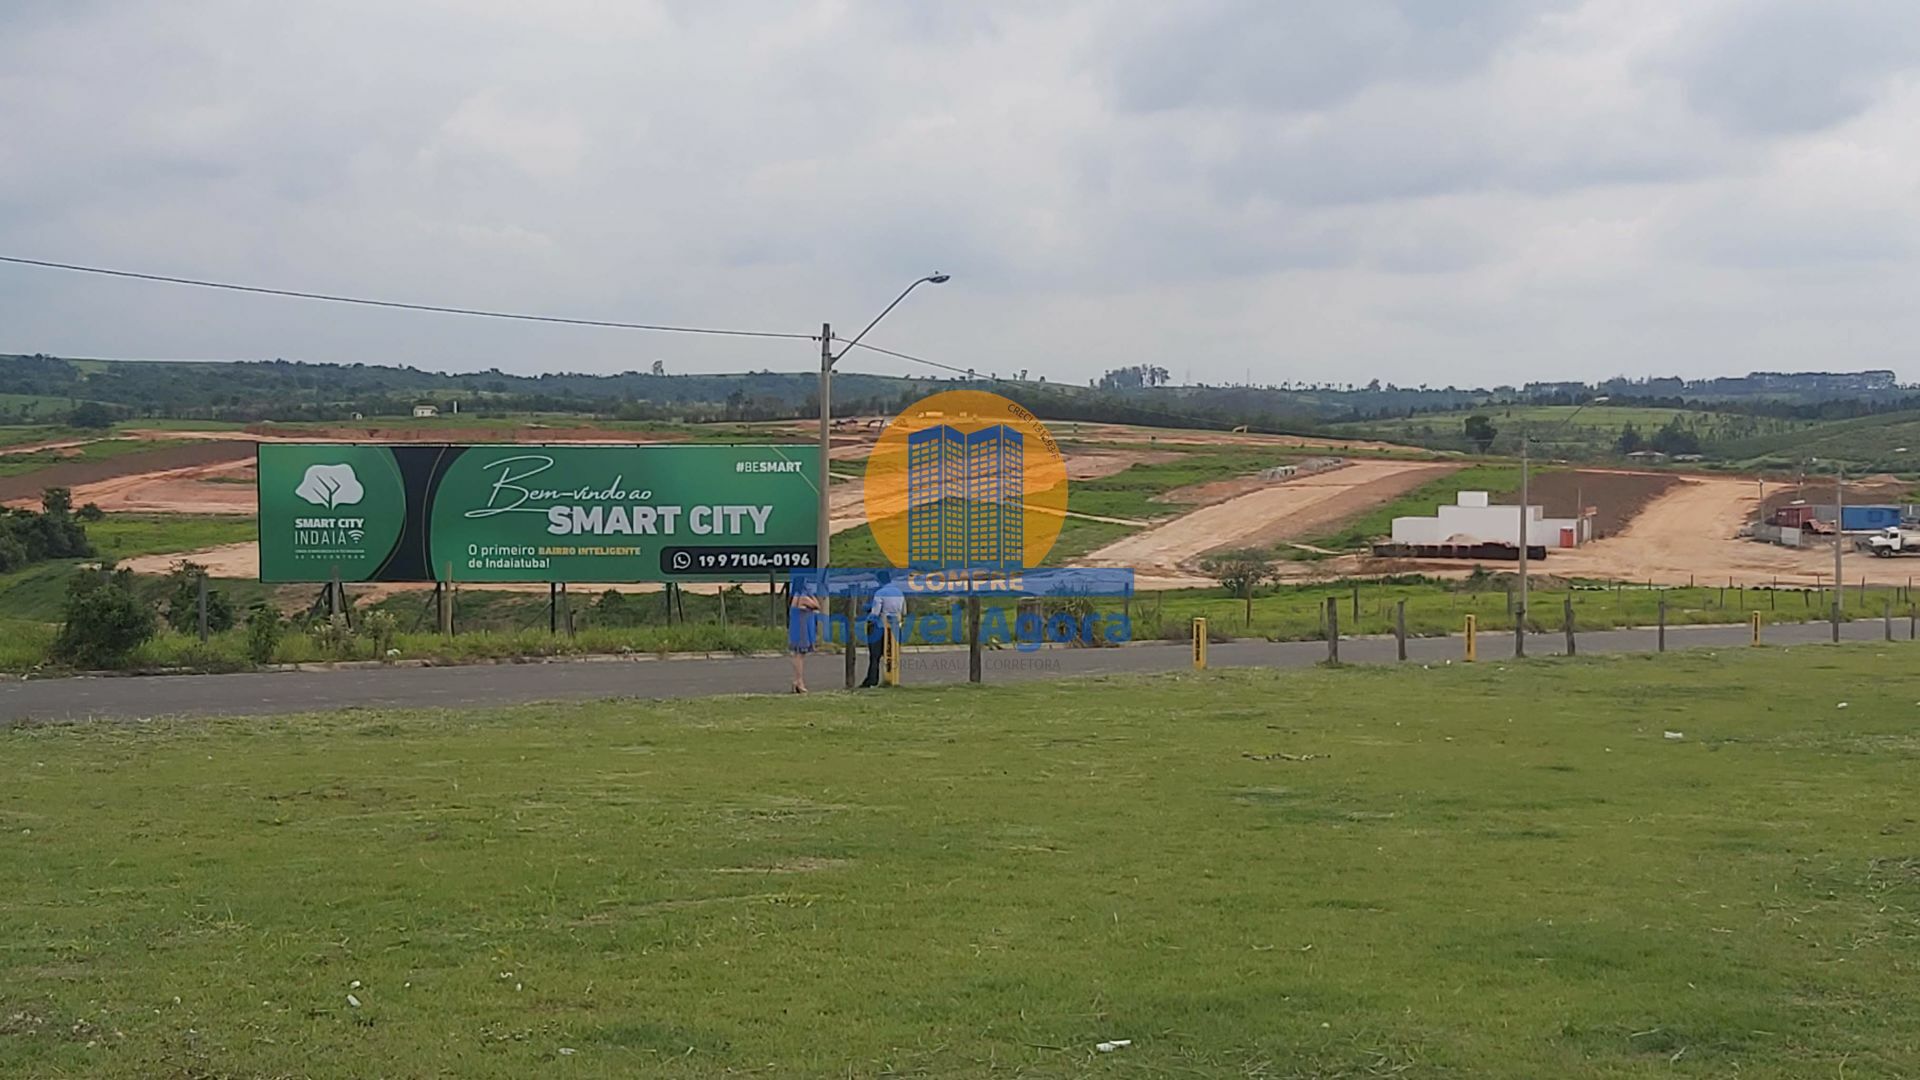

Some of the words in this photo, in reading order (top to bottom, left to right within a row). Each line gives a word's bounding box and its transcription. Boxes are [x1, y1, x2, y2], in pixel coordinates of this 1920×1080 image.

[735, 461, 802, 473] #BESMART
[464, 455, 626, 518] Bem-vindo
[629, 489, 652, 500] ao
[294, 518, 336, 529] SMART
[337, 518, 365, 529] CITY
[548, 505, 682, 535] SMART
[689, 505, 774, 535] CITY
[468, 543, 478, 556] O
[481, 543, 536, 558] primeiro
[537, 546, 576, 556] BAIRRO
[468, 557, 483, 569] de
[485, 557, 551, 569] Indaiatuba!
[698, 555, 716, 567] 19
[717, 554, 728, 566] 9
[730, 553, 811, 566] 7104-0196
